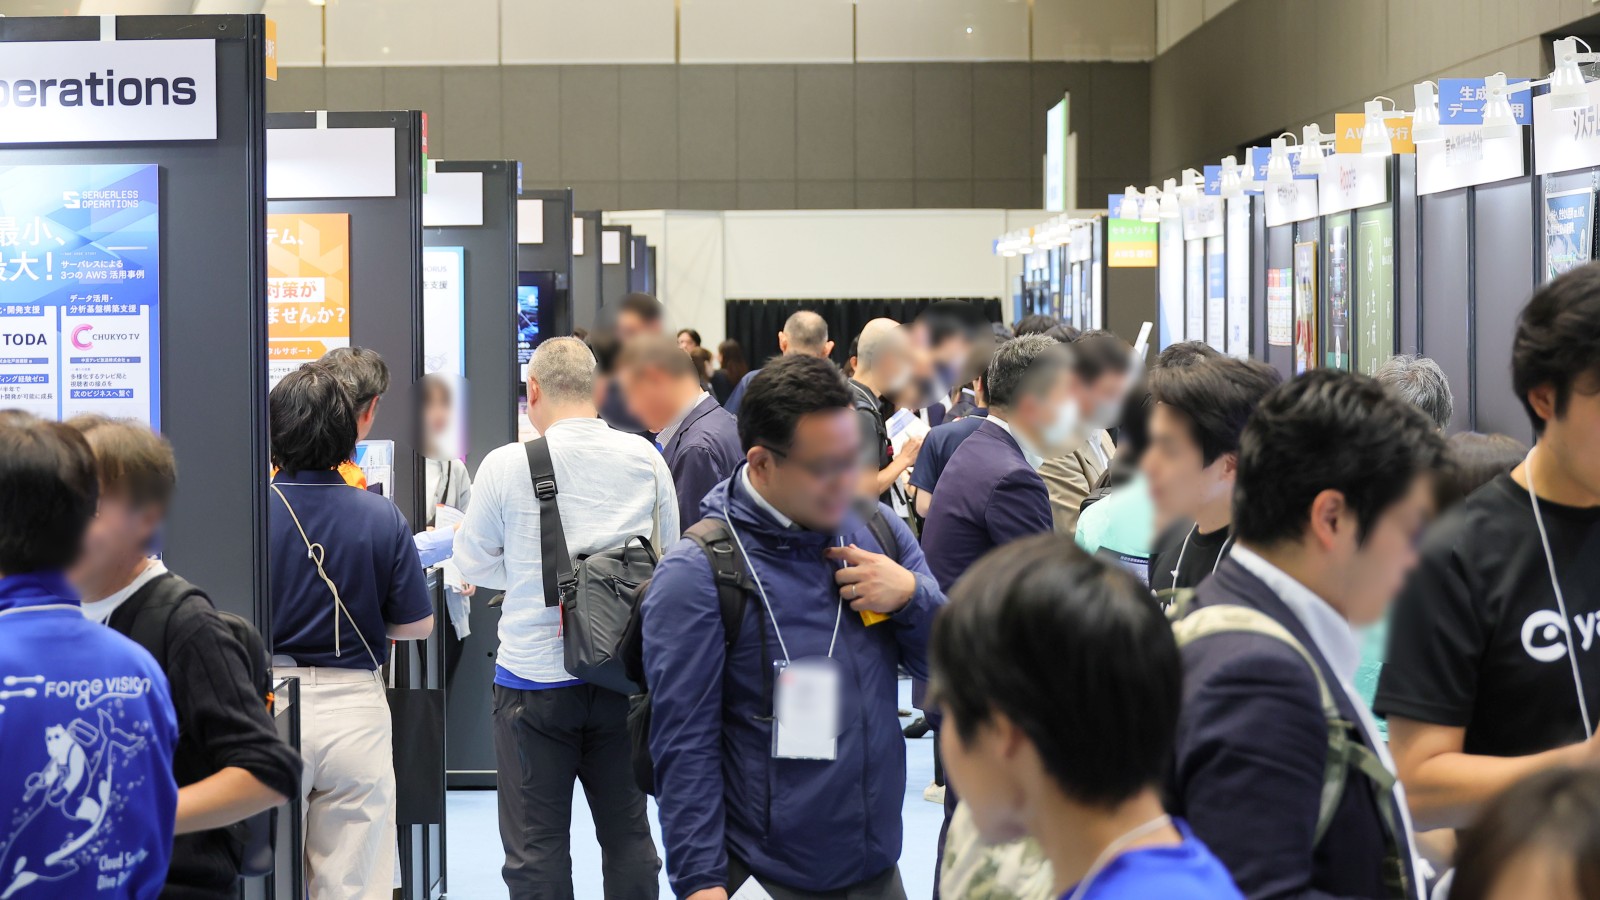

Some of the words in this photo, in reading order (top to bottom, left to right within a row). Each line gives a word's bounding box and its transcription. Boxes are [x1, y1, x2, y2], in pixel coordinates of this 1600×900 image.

[1448, 103, 1524, 118] データ用
[82, 190, 139, 199] SERVERLESS
[82, 200, 139, 209] OPERATIONS
[0, 251, 53, 282] 大！
[60, 260, 124, 269] サーバレスによる
[60, 271, 84, 280] 3つの
[85, 271, 108, 279] AWS
[109, 270, 145, 280] 活用事例
[0, 305, 41, 315] ・開発支援
[69, 304, 138, 314] 分析基盤構築支援
[268, 306, 347, 325] ませんか？
[2, 333, 48, 346] TODA
[92, 333, 128, 341] CHUKYO
[129, 333, 140, 341] TV
[0, 375, 45, 383] ィング経験ゼロ
